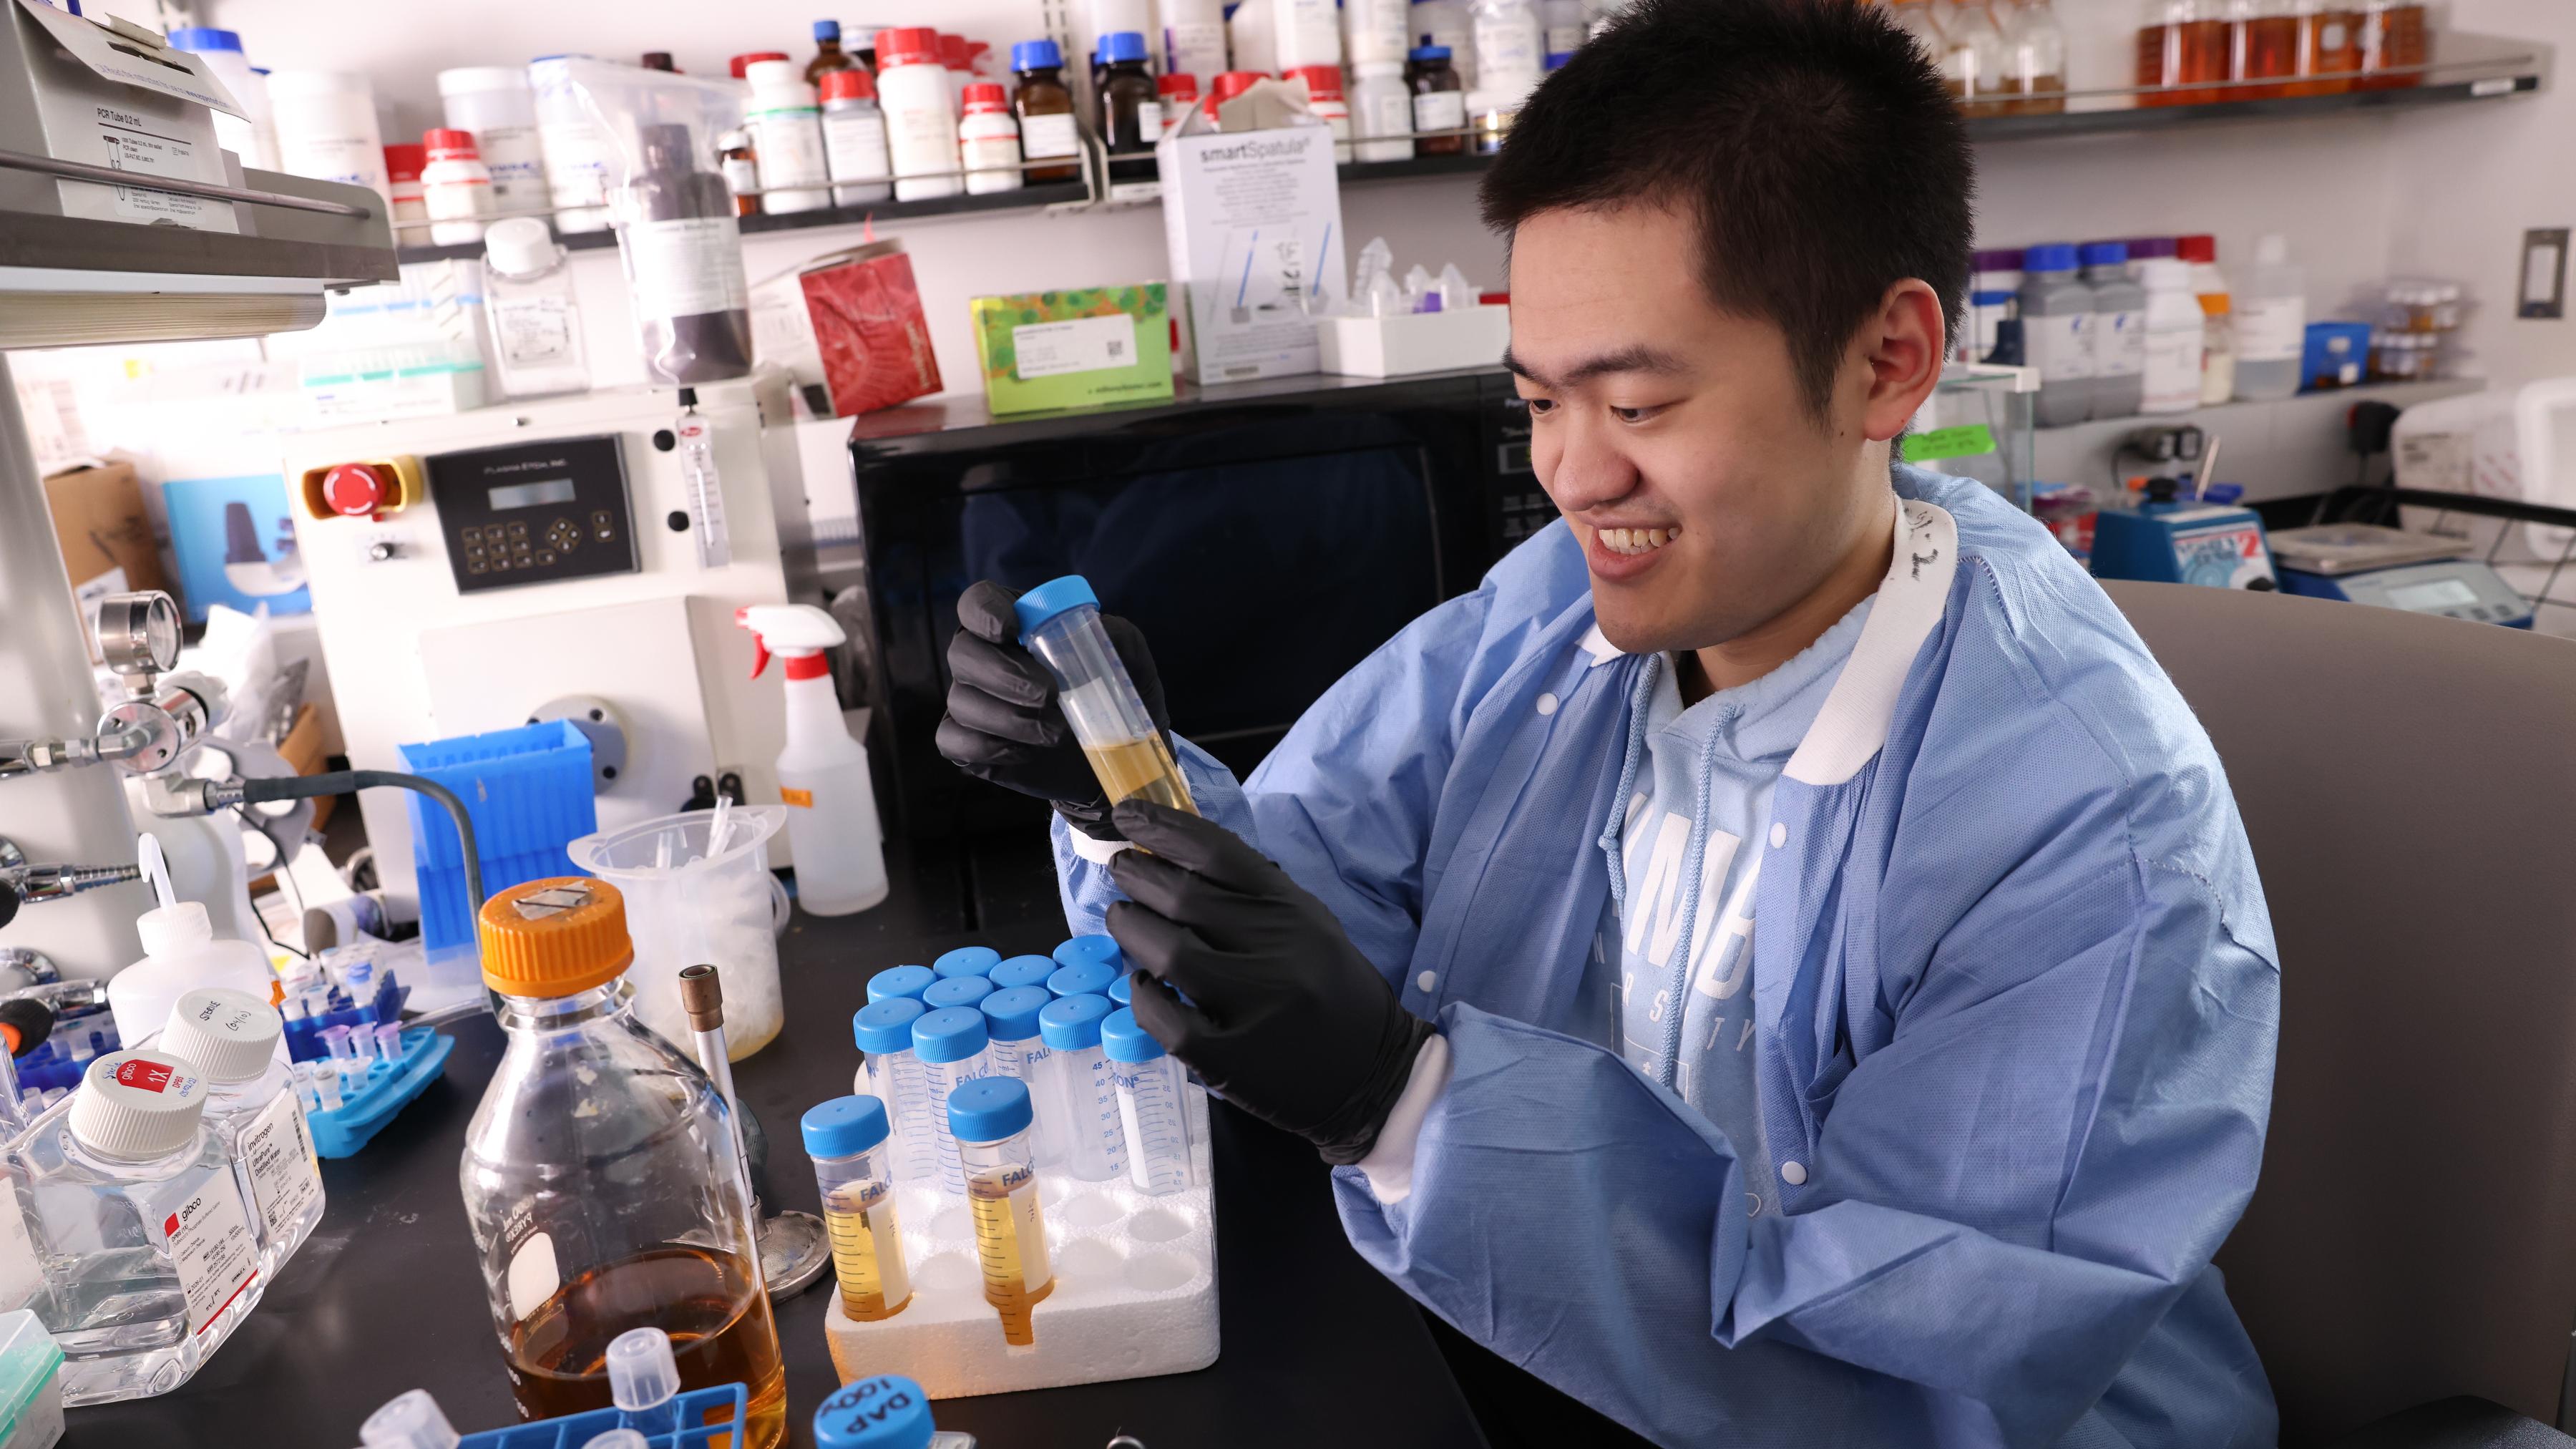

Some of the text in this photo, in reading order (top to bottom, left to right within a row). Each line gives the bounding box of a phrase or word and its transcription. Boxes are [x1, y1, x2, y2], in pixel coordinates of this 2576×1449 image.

[97, 108, 142, 127] PCR Tube 0.2 mL
[200, 1000, 221, 1021] STERILE
[122, 1063, 137, 1080] gibco
[1092, 1062, 1103, 1070] 45
[147, 1069, 170, 1083] 1X
[172, 1076, 184, 1088] DPBS
[1096, 1078, 1105, 1087] 40
[1098, 1095, 1108, 1104] 35
[1101, 1112, 1111, 1121] 30
[247, 1122, 273, 1152] invitrogen
[1103, 1129, 1113, 1138] 25
[1106, 1146, 1116, 1155] 20
[255, 1157, 270, 1177] Distilled
[270, 1147, 281, 1161] Water
[1110, 1163, 1119, 1171] 15
[182, 1197, 201, 1221] gibco
[171, 1230, 181, 1242] DPBS
